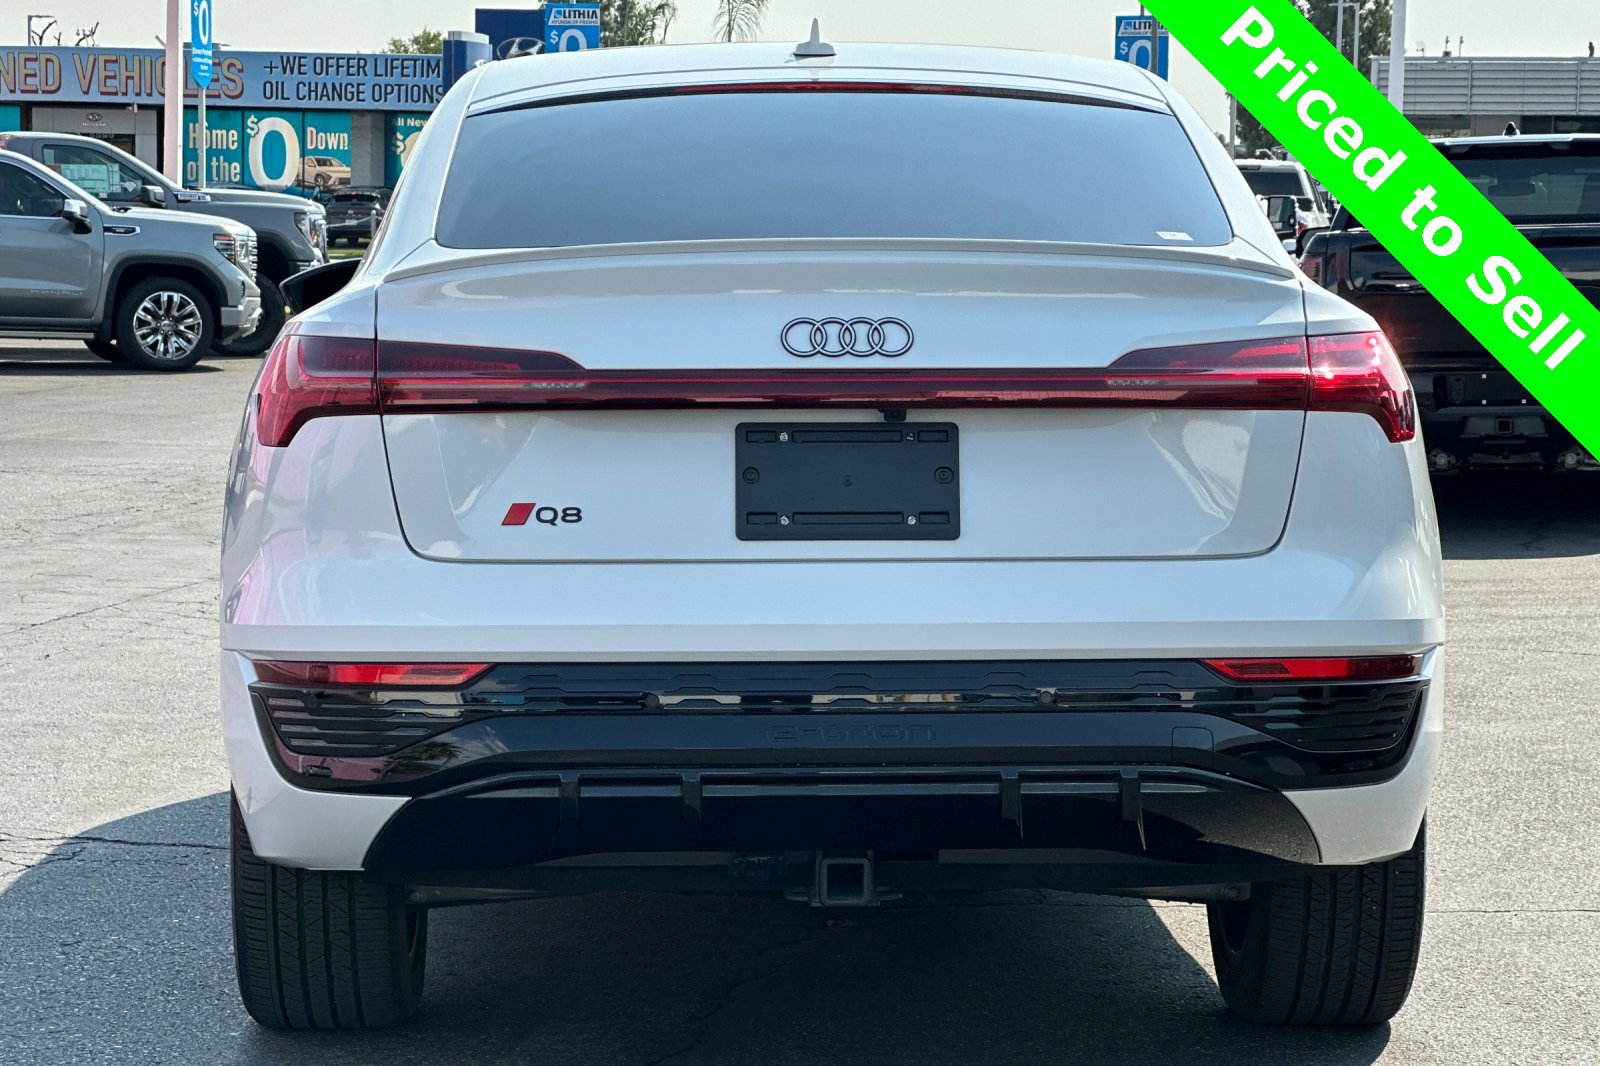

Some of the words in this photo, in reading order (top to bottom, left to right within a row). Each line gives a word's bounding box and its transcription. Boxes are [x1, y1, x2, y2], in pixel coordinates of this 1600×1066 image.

[563, 9, 598, 19] LITHIA
[0, 52, 62, 95] NED
[263, 55, 307, 76] +WE
[313, 56, 368, 77] OFFER
[373, 58, 441, 79] LIFETIM
[262, 80, 291, 101] OIL
[296, 82, 366, 103] CHANGE
[371, 83, 444, 104] OPTIONS
[306, 126, 348, 150] Down
[246, 114, 300, 192] $0
[211, 155, 241, 182] the
[535, 506, 583, 526] Q8
